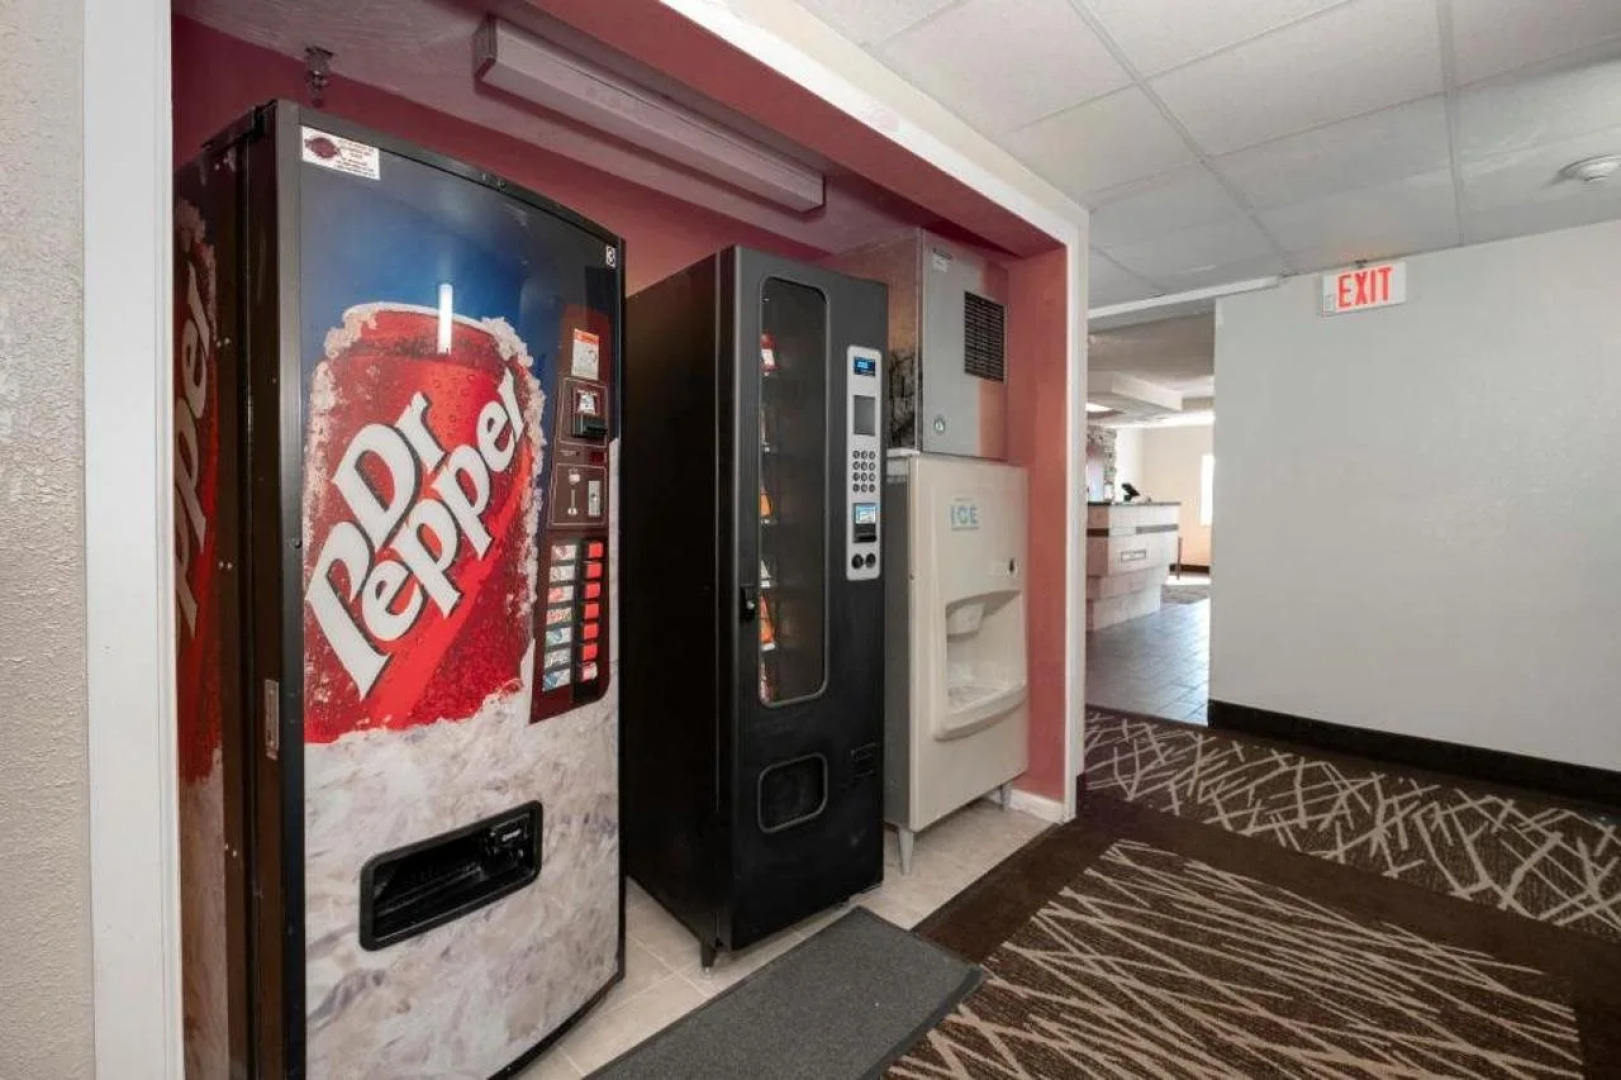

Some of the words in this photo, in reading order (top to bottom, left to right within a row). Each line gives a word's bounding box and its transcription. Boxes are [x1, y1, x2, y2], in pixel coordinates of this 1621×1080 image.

[1337, 265, 1392, 308] EXIT
[331, 391, 447, 553] Dr
[949, 504, 979, 525] ICE
[303, 366, 525, 702] Pepper
